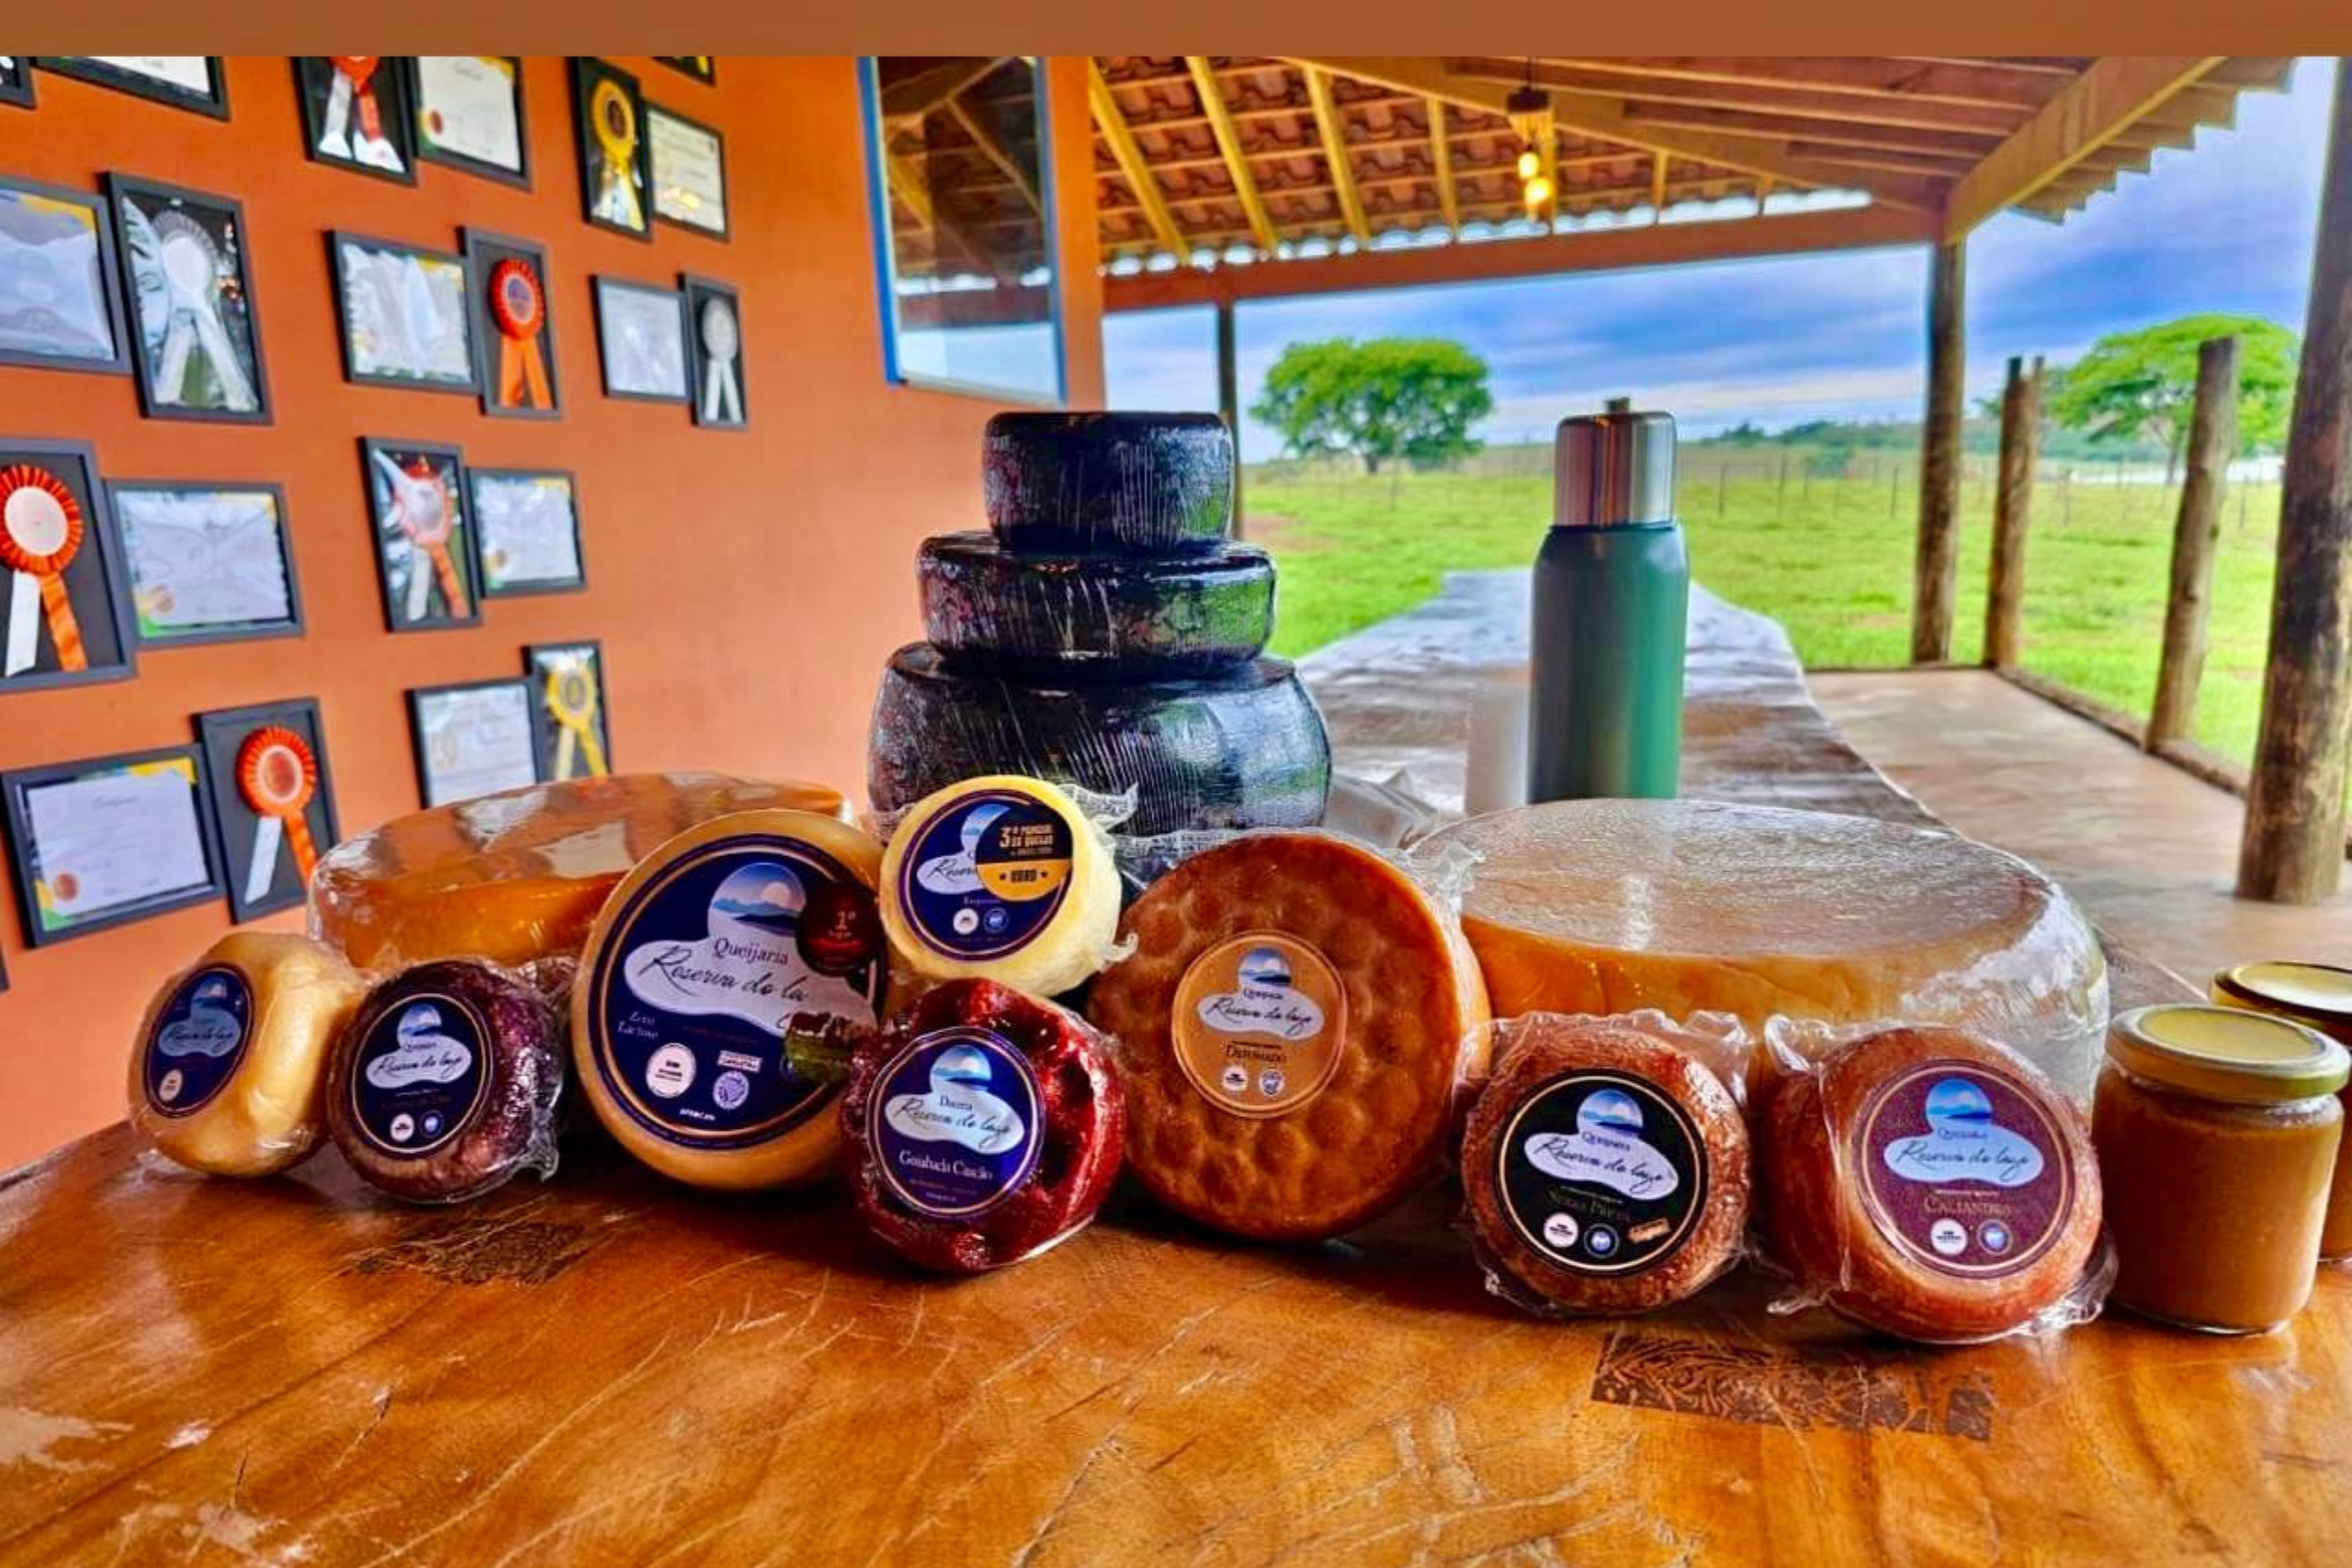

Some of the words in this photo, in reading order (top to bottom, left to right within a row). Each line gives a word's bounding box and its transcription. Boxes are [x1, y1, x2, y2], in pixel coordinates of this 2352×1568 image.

[713, 936, 790, 966] Queijaria
[637, 944, 739, 998] Reserva
[741, 969, 774, 997] do
[899, 1149, 952, 1174] Goiabada
